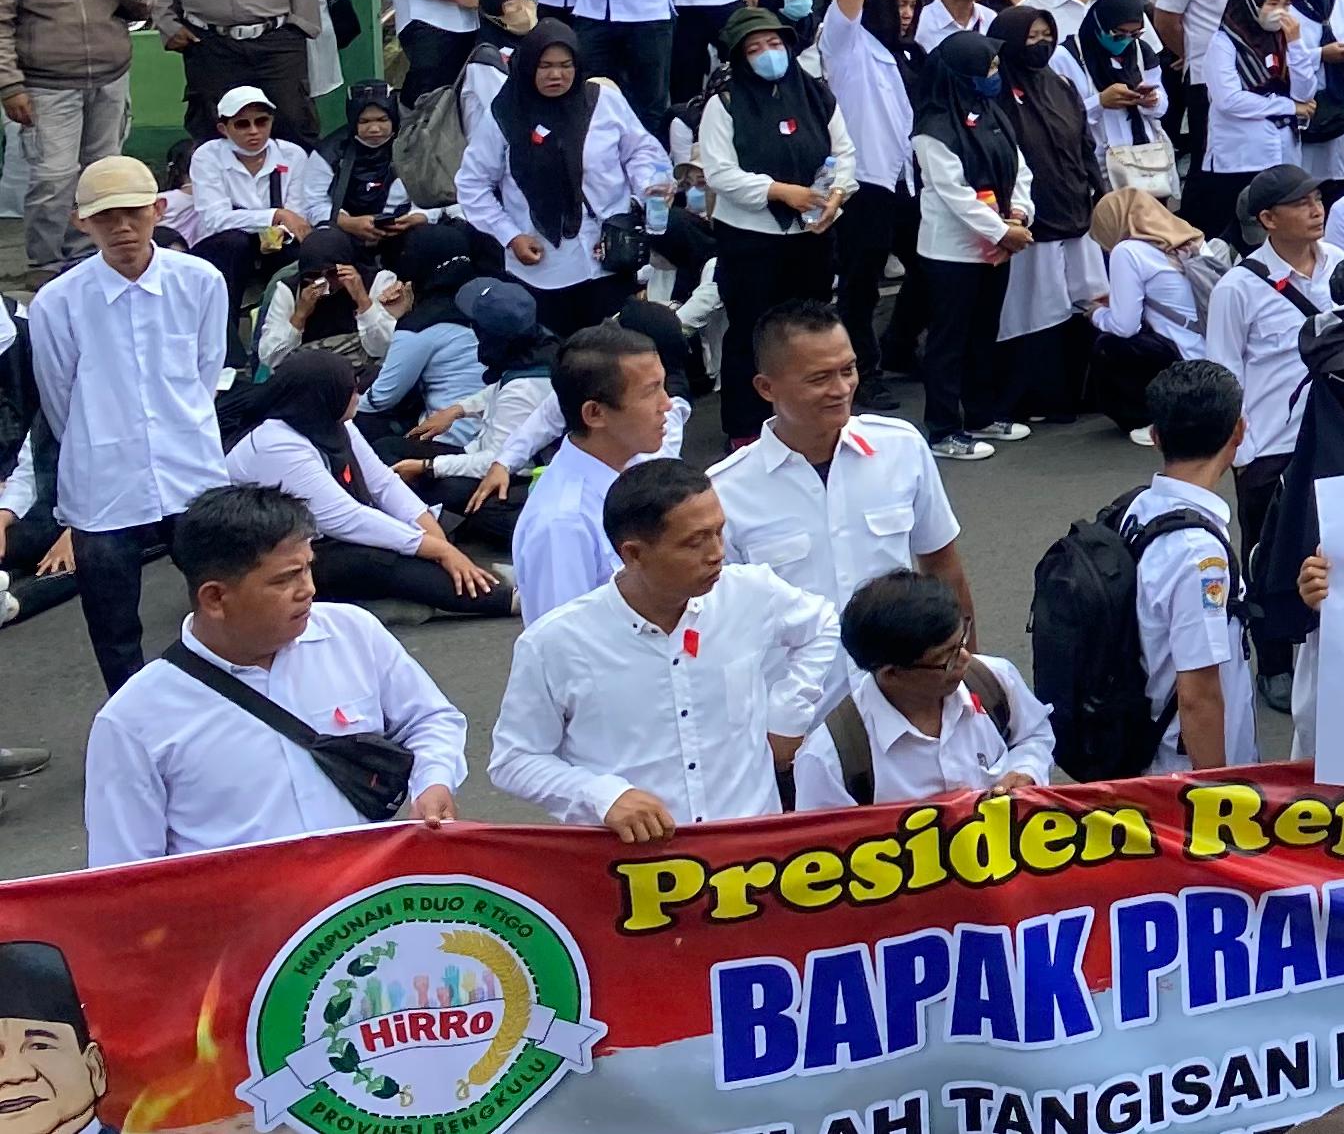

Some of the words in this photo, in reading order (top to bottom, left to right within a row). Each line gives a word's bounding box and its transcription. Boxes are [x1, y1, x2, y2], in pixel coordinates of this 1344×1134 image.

[617, 793, 1157, 931] Presiden
[294, 902, 393, 977] HIMPUNAN
[420, 896, 465, 912] DUO
[718, 914, 1097, 1083] BAPAK
[949, 1040, 1311, 1134] TANGISAN
